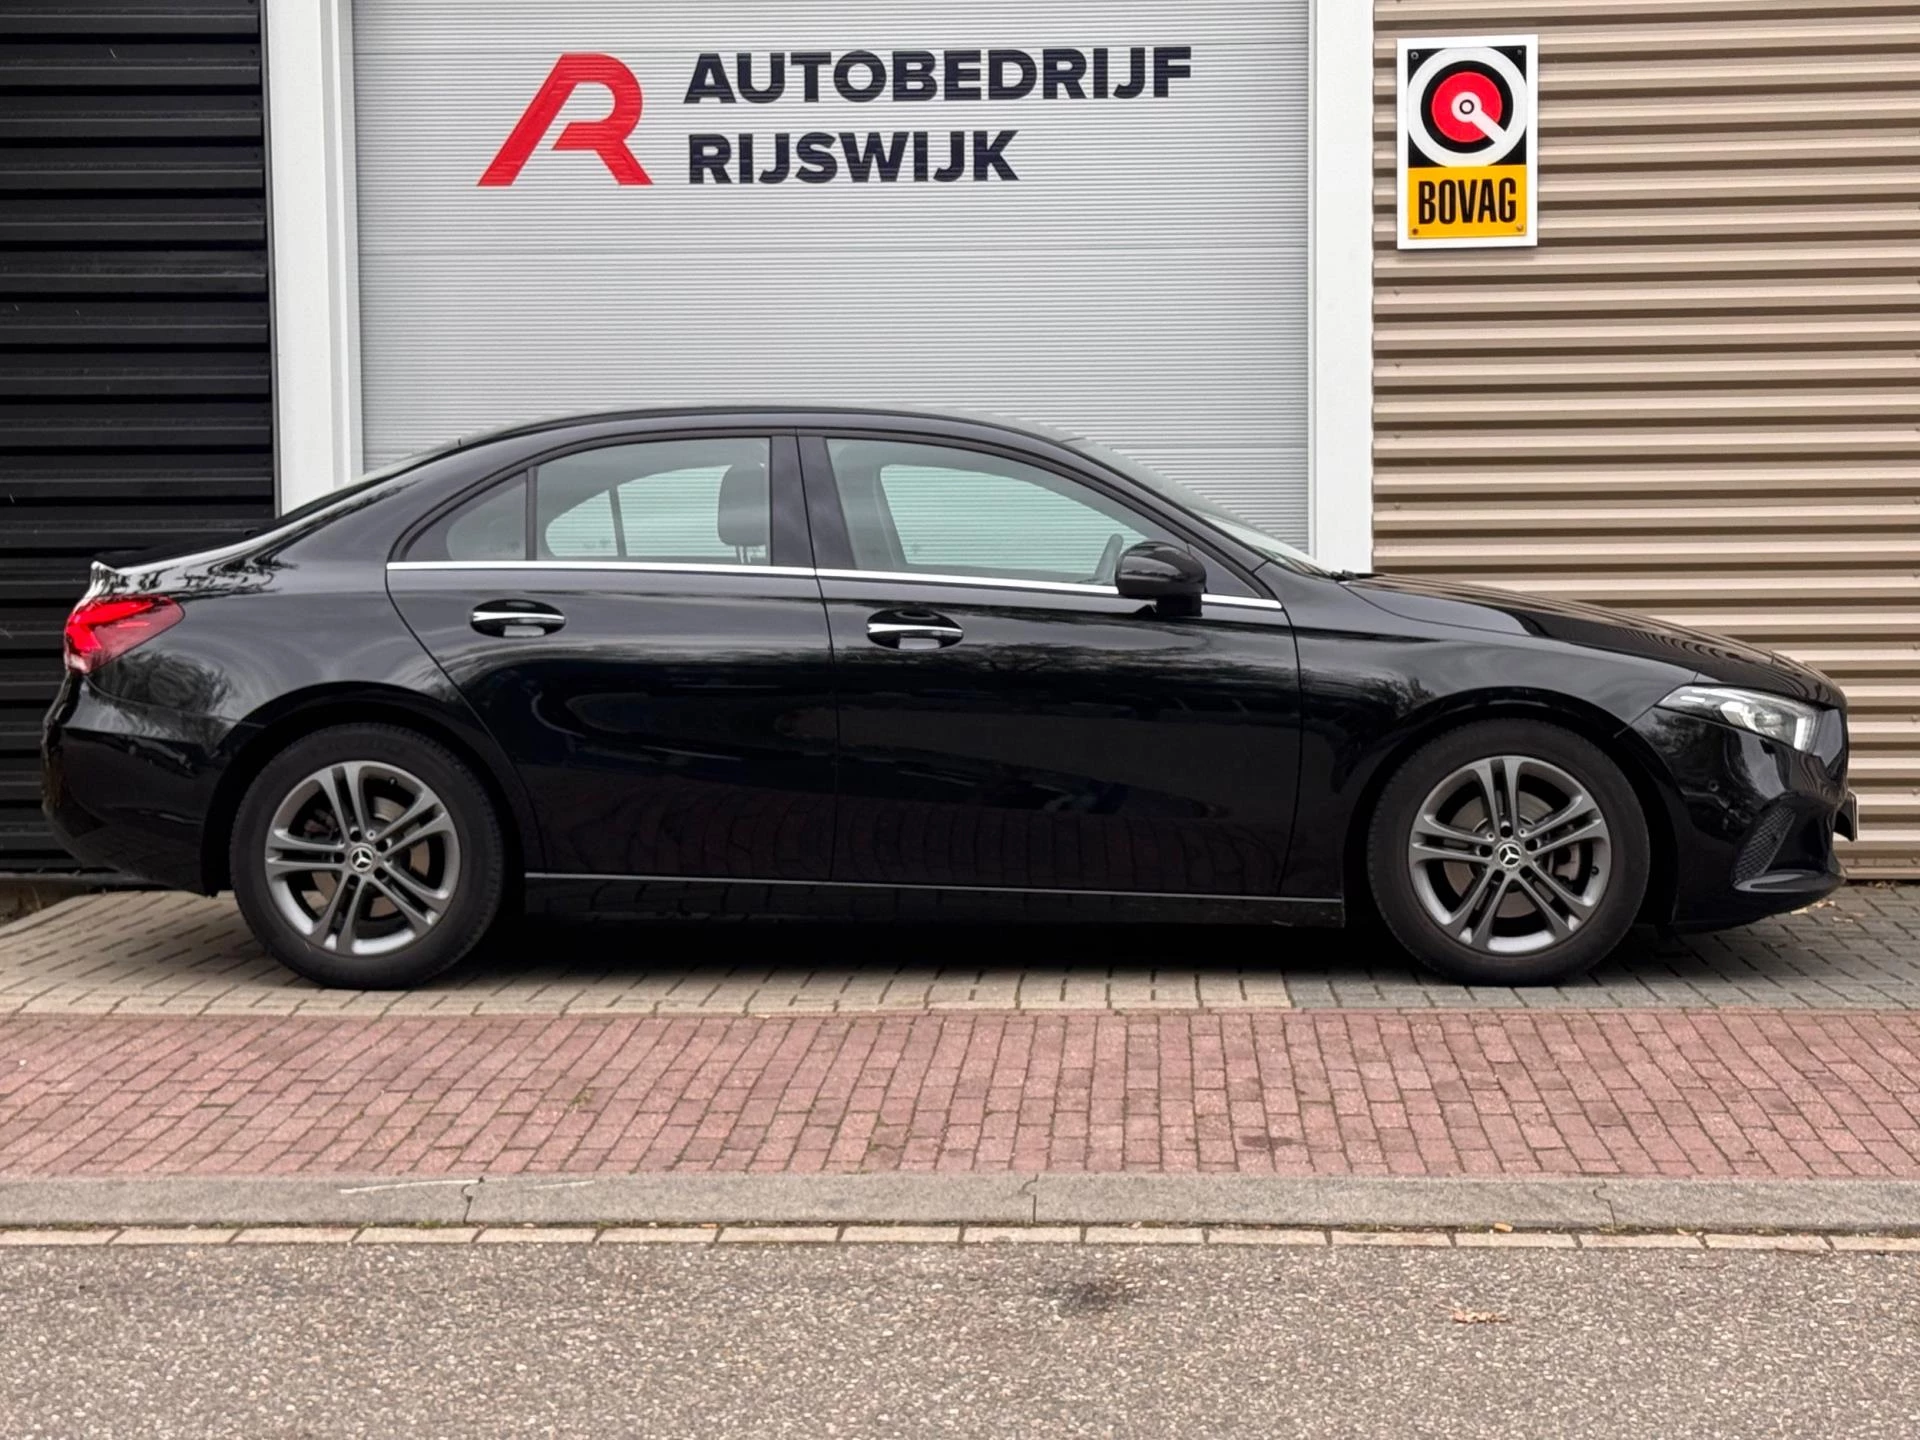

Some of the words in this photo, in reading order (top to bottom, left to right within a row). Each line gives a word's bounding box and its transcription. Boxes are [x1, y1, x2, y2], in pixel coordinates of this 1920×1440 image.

[683, 47, 1192, 103] AUTOBEDRIJF
[688, 130, 1019, 184] RIJSWIJK
[1418, 177, 1517, 224] BOVAG
